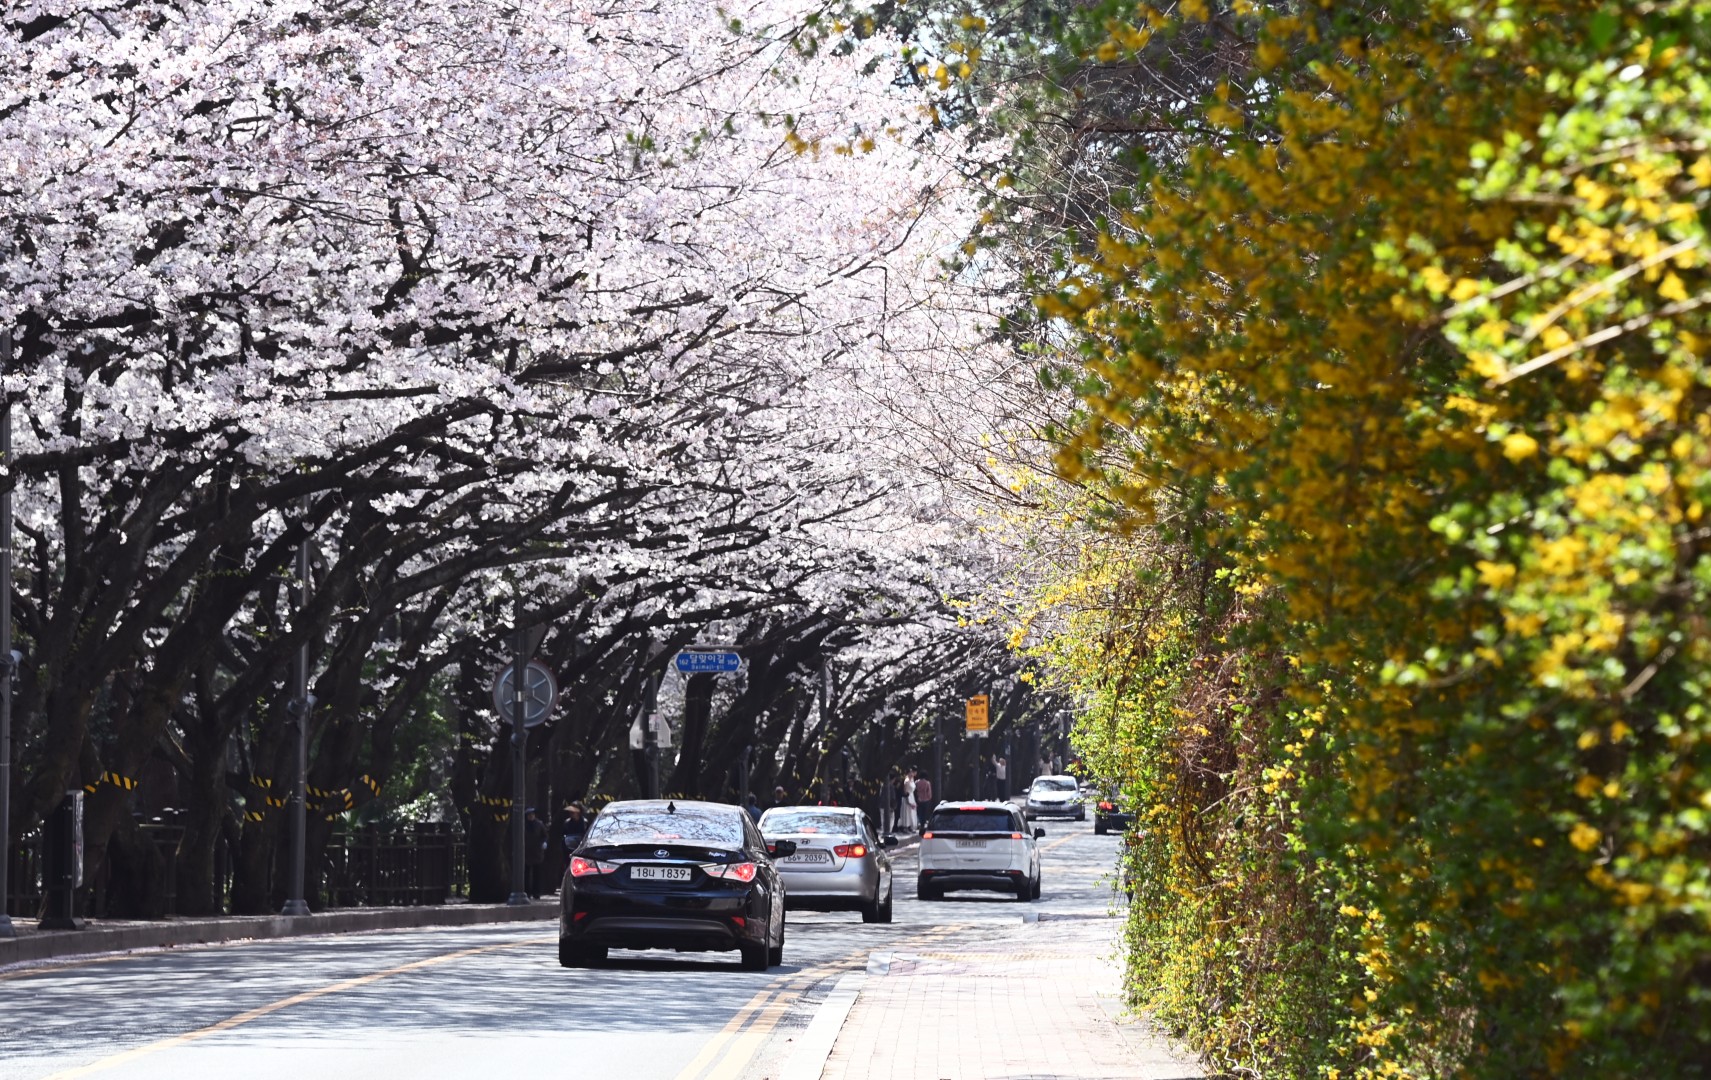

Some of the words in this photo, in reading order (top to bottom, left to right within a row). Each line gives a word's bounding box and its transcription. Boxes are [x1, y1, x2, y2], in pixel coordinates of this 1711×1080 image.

[690, 654, 725, 664] 달맞이길
[804, 853, 823, 861] 2039
[636, 868, 655, 877] 18나
[660, 868, 687, 879] 1839
